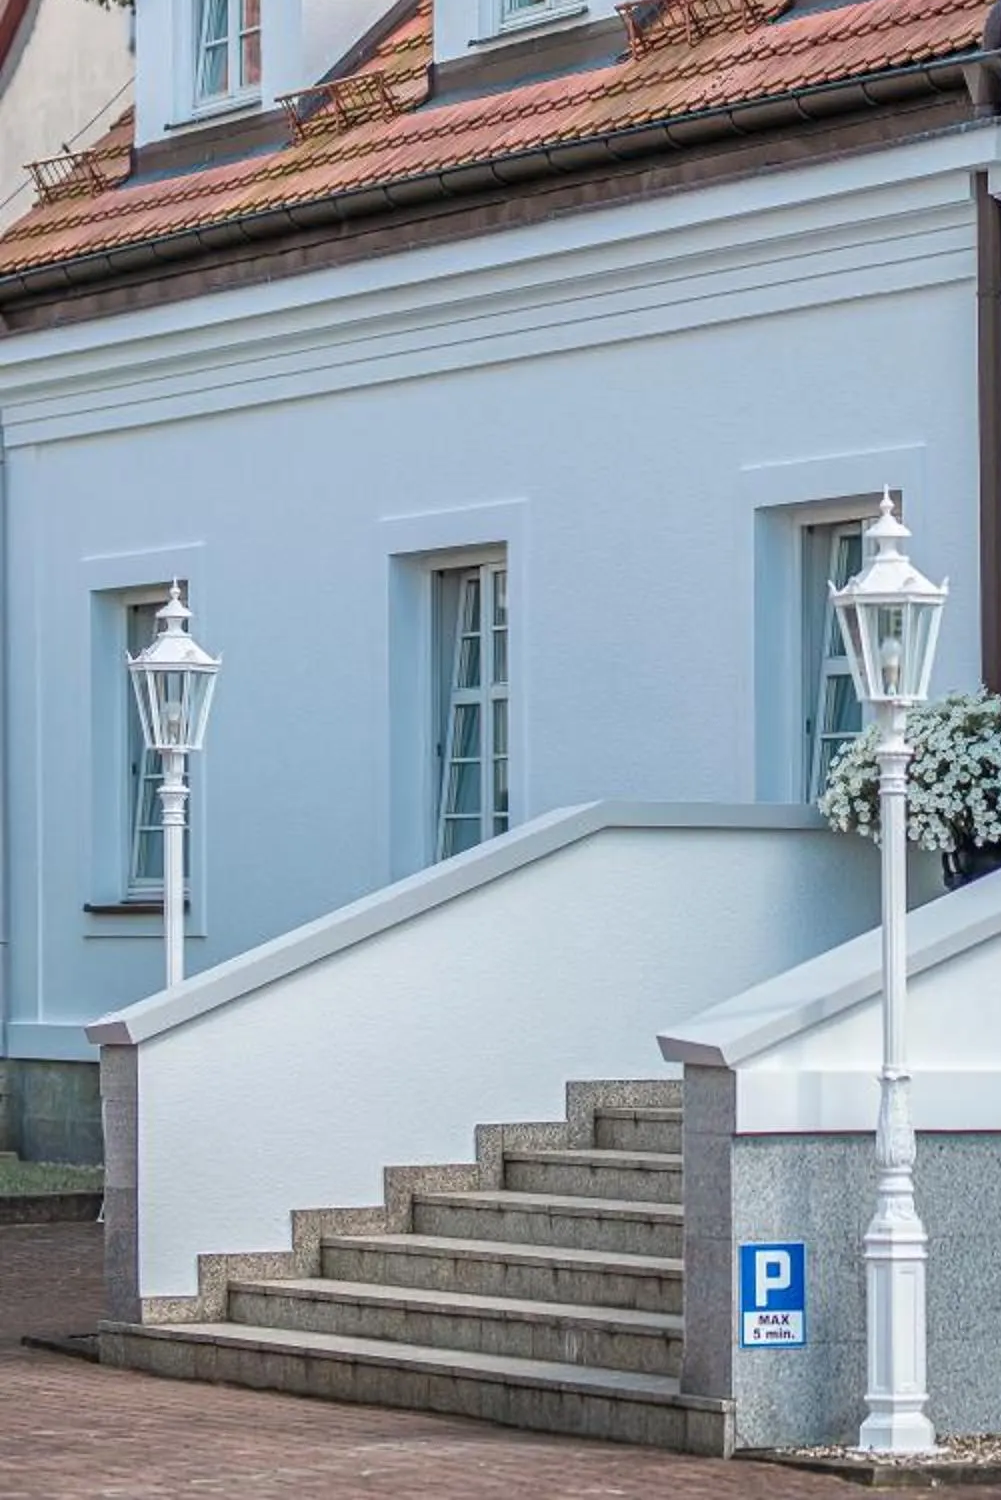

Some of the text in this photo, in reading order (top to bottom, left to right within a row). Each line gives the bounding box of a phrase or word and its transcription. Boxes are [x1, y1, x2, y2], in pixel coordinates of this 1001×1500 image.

[756, 1250, 790, 1306] P
[758, 1314, 789, 1325] MAX
[753, 1328, 795, 1339] 5 min.
